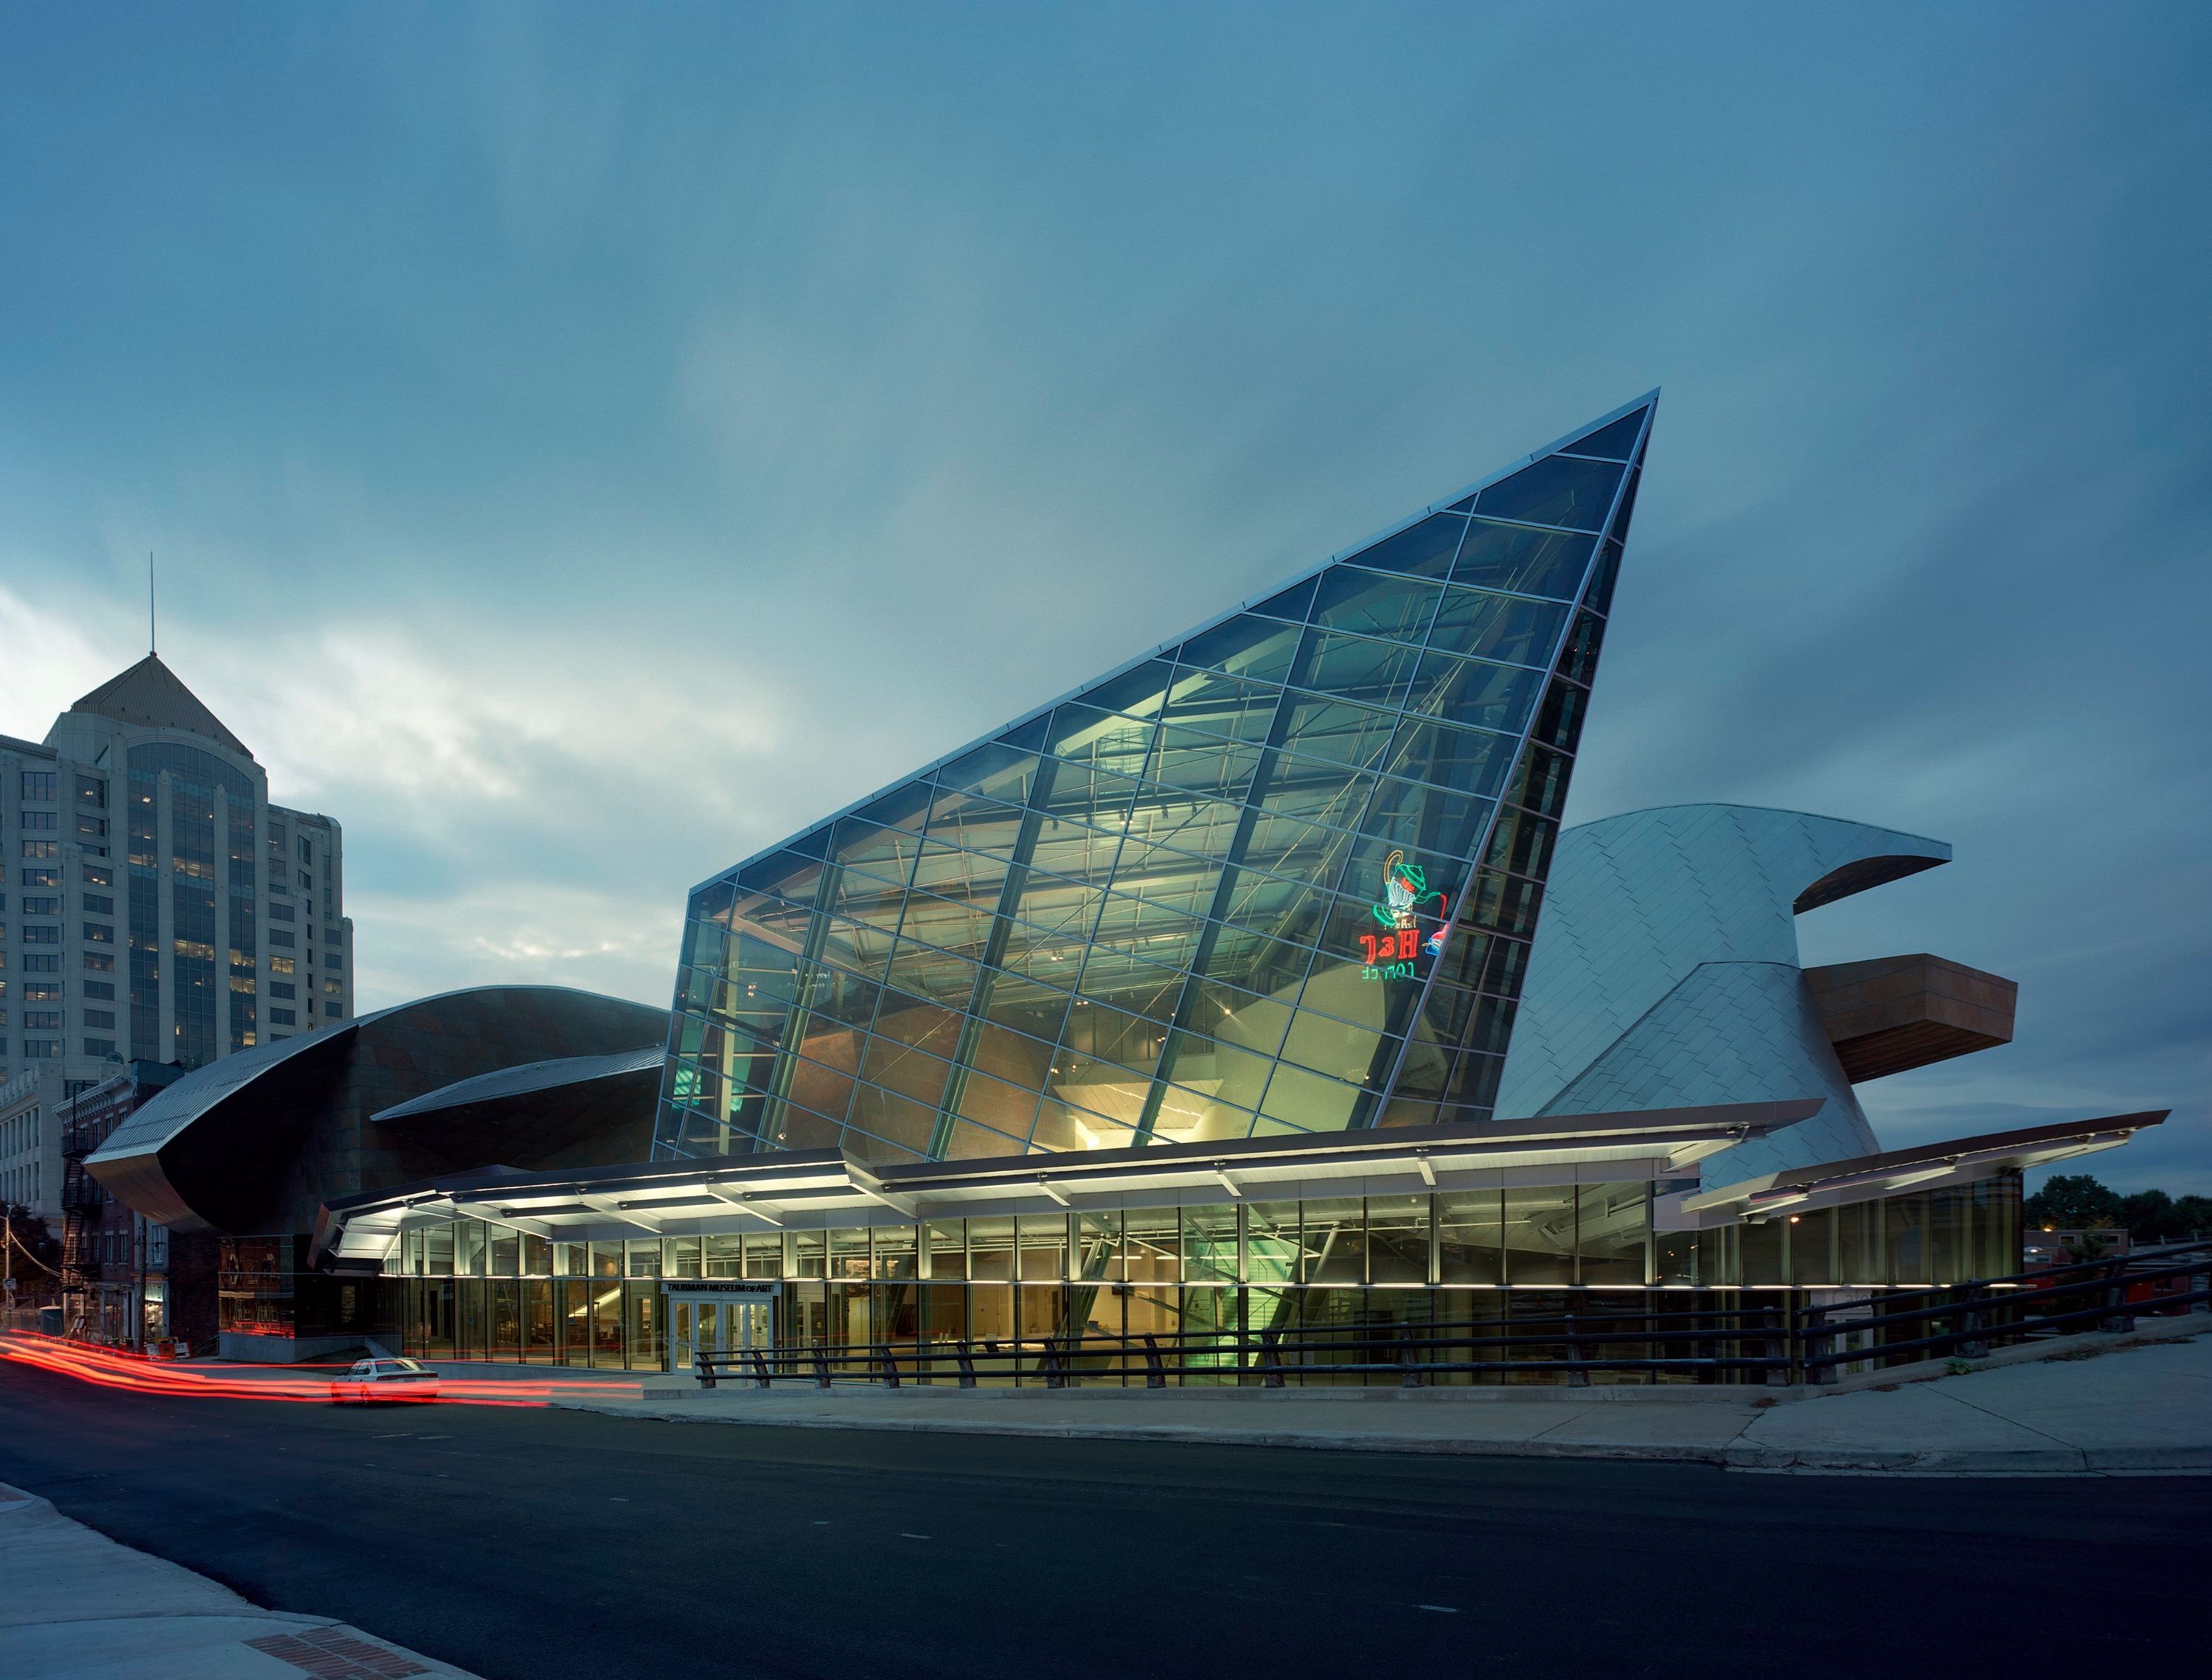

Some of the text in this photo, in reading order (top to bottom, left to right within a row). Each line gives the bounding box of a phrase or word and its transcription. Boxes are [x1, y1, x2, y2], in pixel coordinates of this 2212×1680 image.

[667, 1283, 708, 1292] TAUBMAN
[709, 1283, 745, 1293] MUSEUM
[756, 1285, 774, 1293] ART
